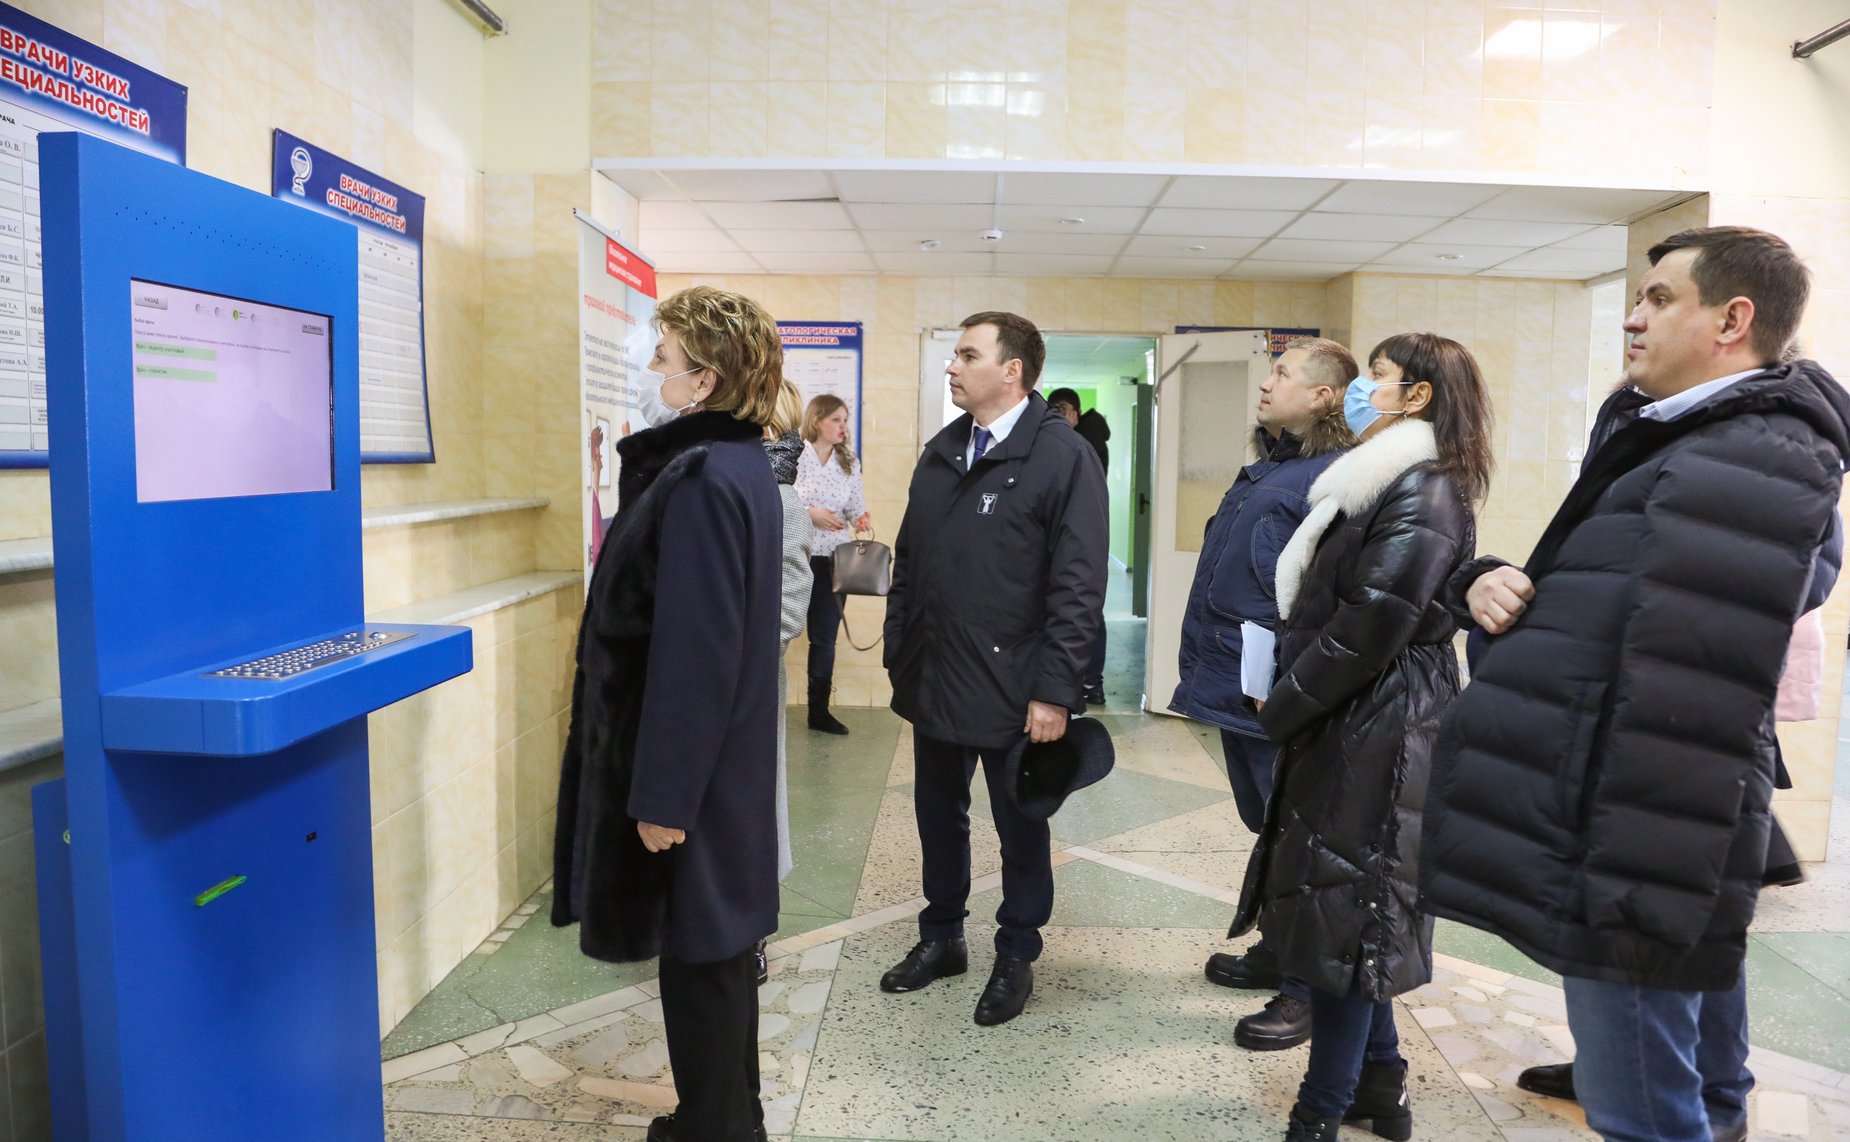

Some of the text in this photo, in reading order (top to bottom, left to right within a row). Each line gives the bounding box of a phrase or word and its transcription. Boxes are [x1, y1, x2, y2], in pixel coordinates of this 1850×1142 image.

[0, 27, 129, 100] ВРАЧИ УЗКИХ
[0, 57, 150, 133] ЕЦИАЛЬНОСТЕЙ
[327, 190, 405, 231] СПЕЦИАЛЬНОСТЕЙ
[340, 175, 397, 211] ВРАЧИ УЗКИХ
[777, 327, 857, 335] АТОЛОГИЧЕСКАЯ
[782, 336, 839, 344] ЛИКЛИНИКА
